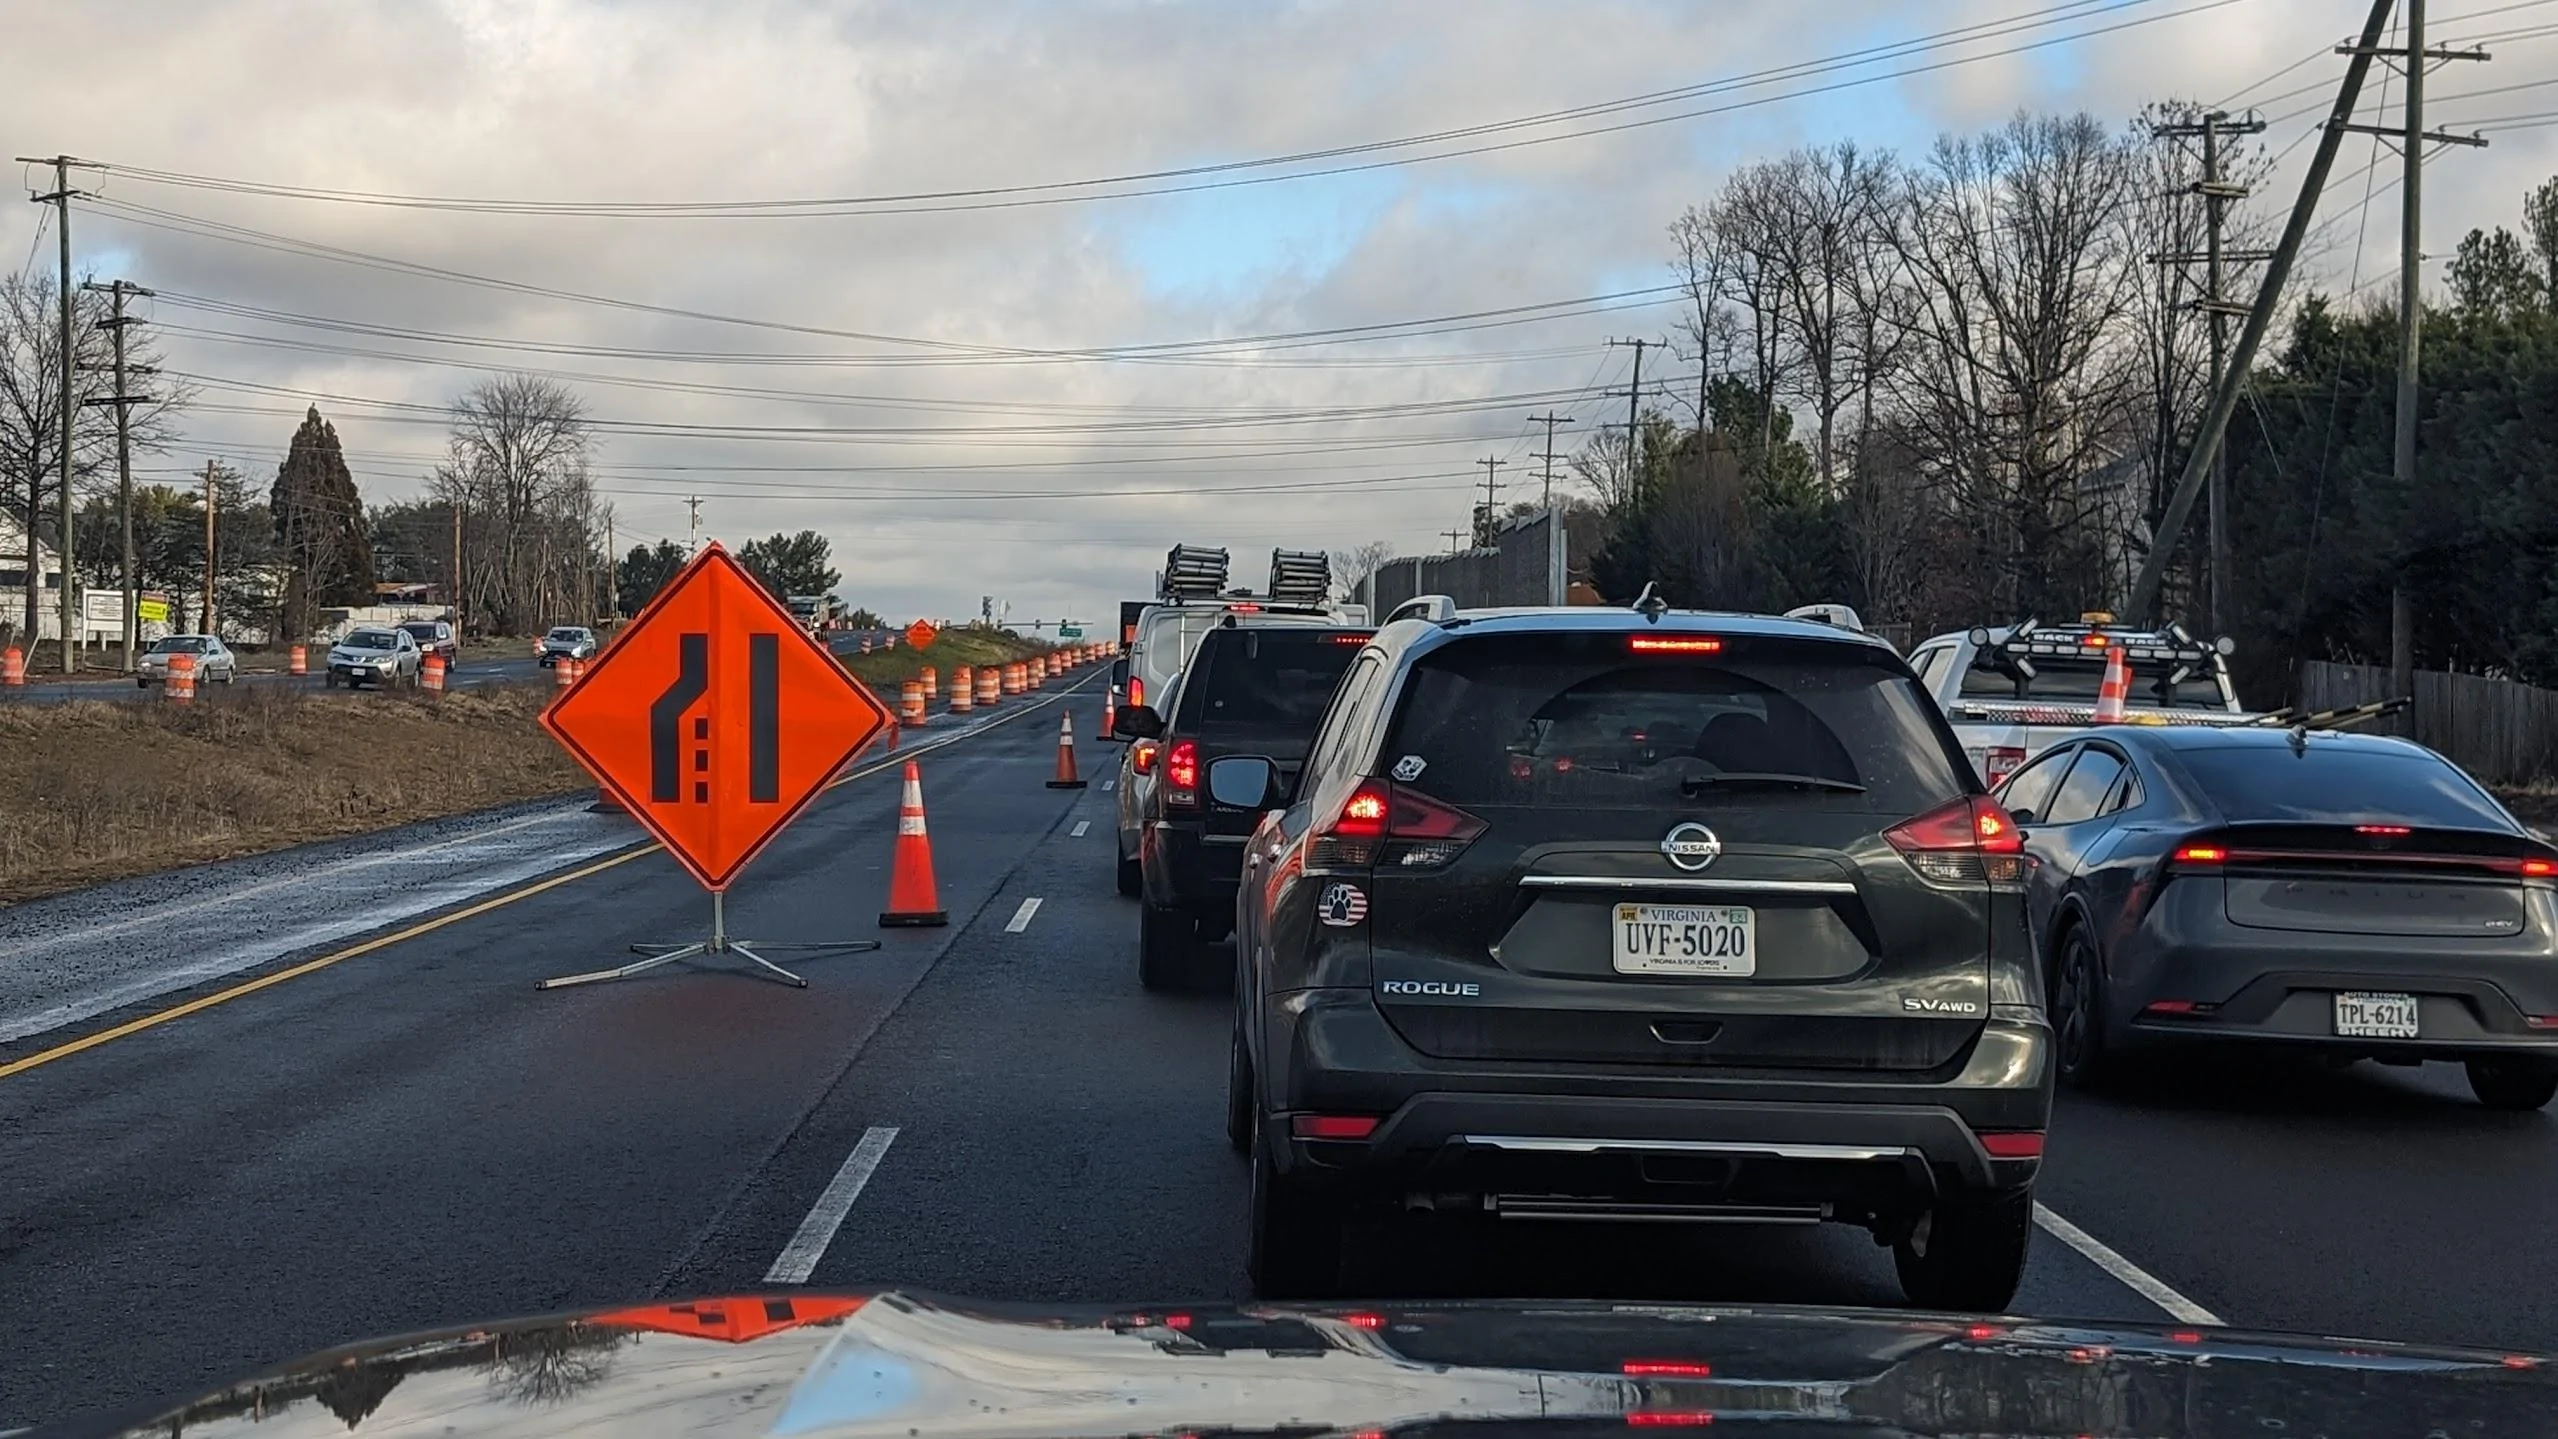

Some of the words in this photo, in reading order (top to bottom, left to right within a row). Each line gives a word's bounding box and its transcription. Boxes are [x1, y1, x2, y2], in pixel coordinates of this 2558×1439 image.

[1668, 844, 1716, 853] NISSAN
[1651, 909, 1717, 923] VIRGINIA
[1625, 923, 1746, 957] UVF-5020
[1383, 981, 1480, 996] ROGUE
[2339, 1004, 2416, 1026] TPL-6214
